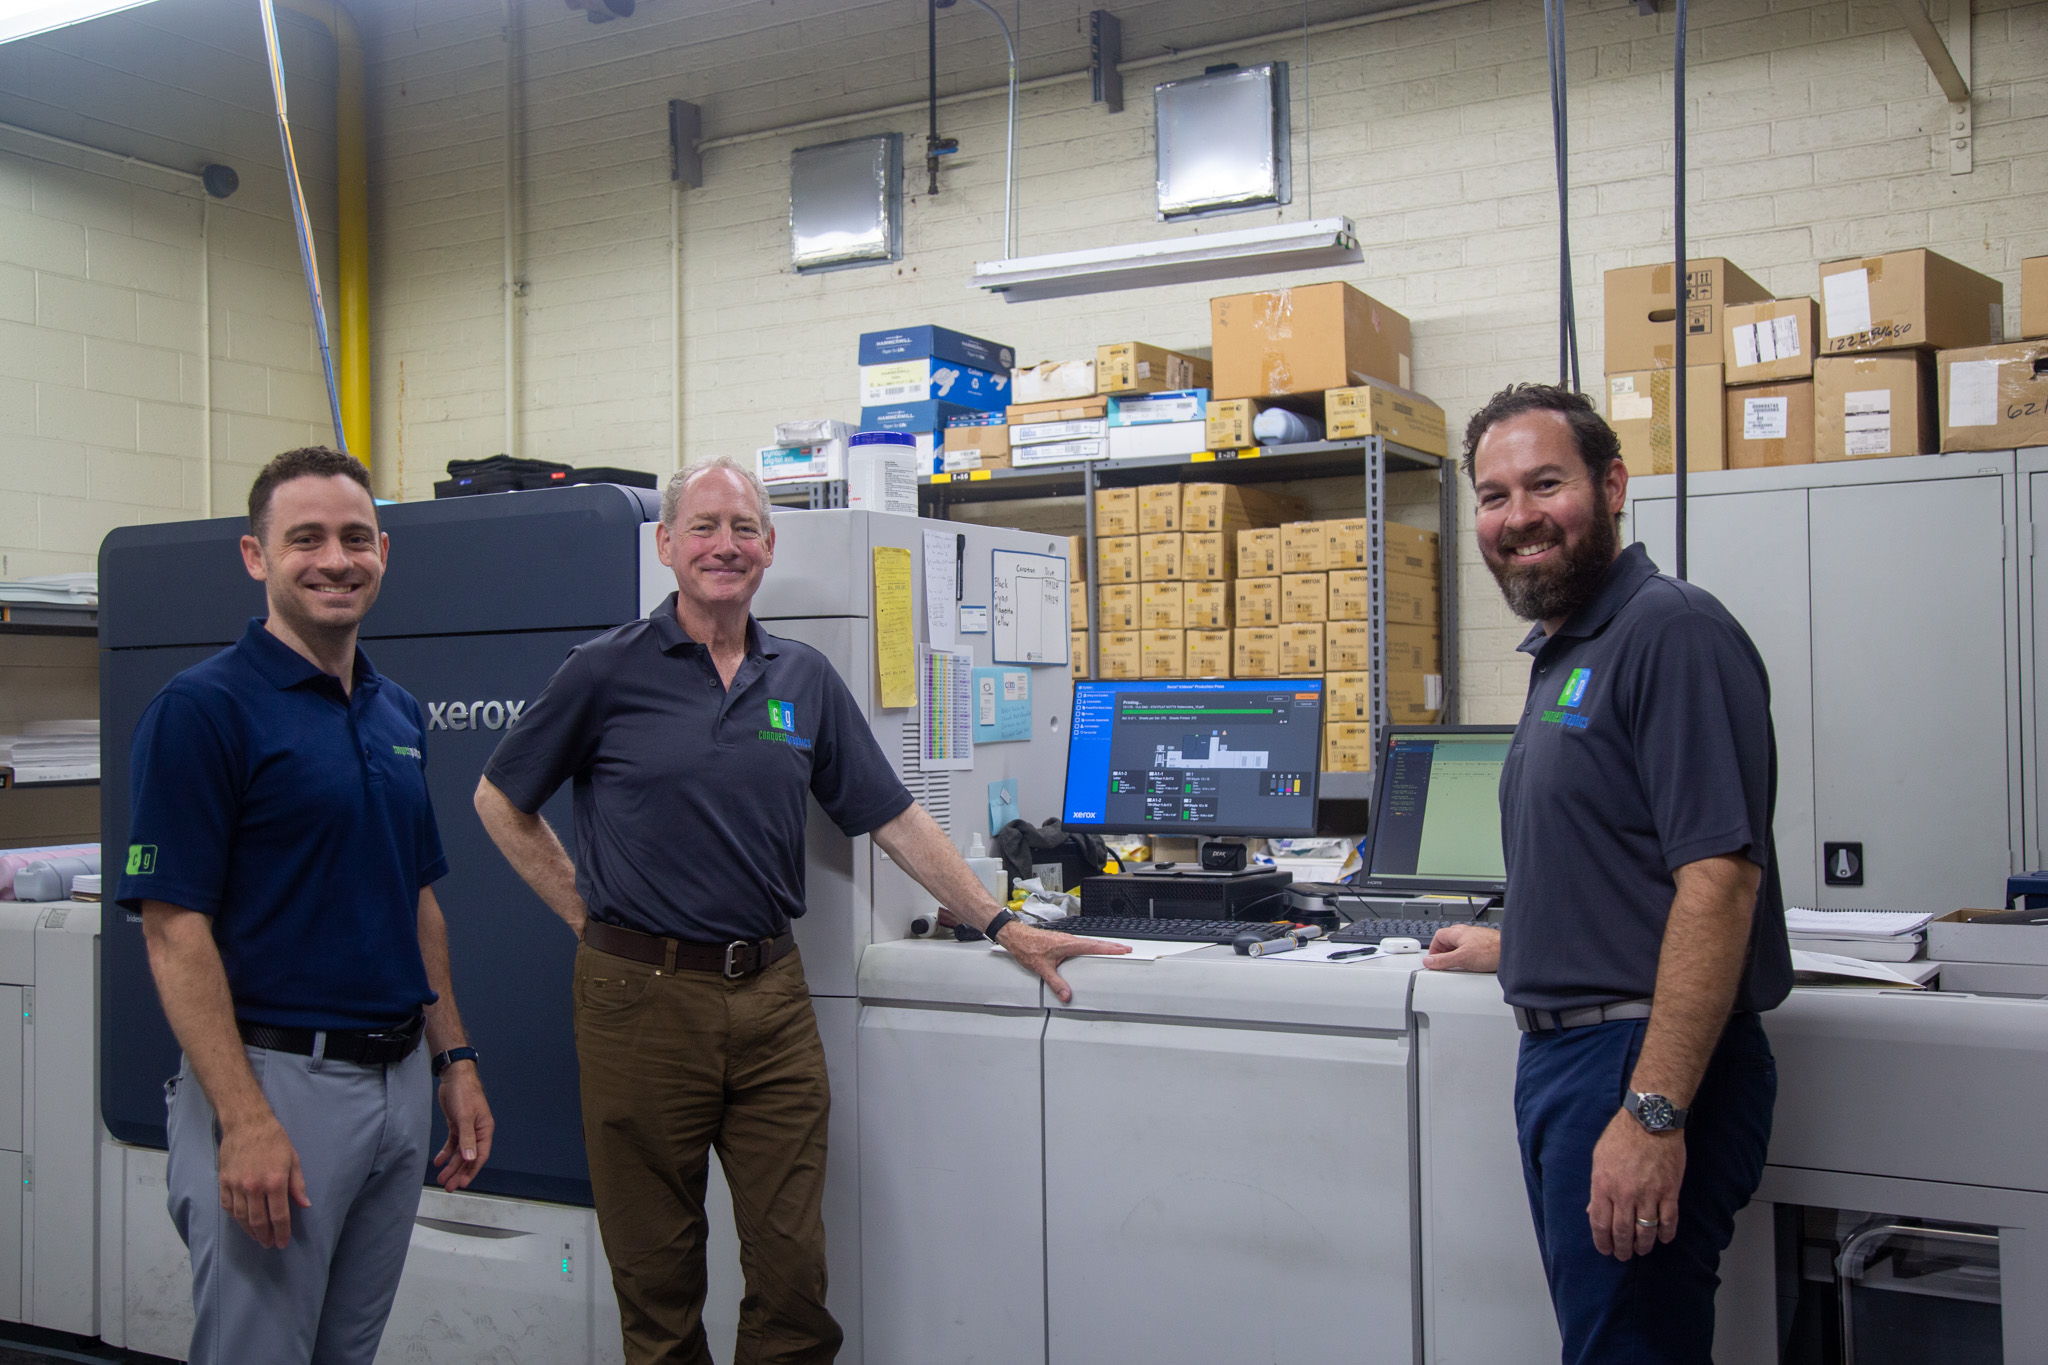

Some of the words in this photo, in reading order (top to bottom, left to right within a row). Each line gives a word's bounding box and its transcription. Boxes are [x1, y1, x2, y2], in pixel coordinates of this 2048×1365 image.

[876, 338, 912, 346] HAMMERMILL
[877, 413, 915, 421] HAMMERMILL
[428, 700, 526, 730] xerox
